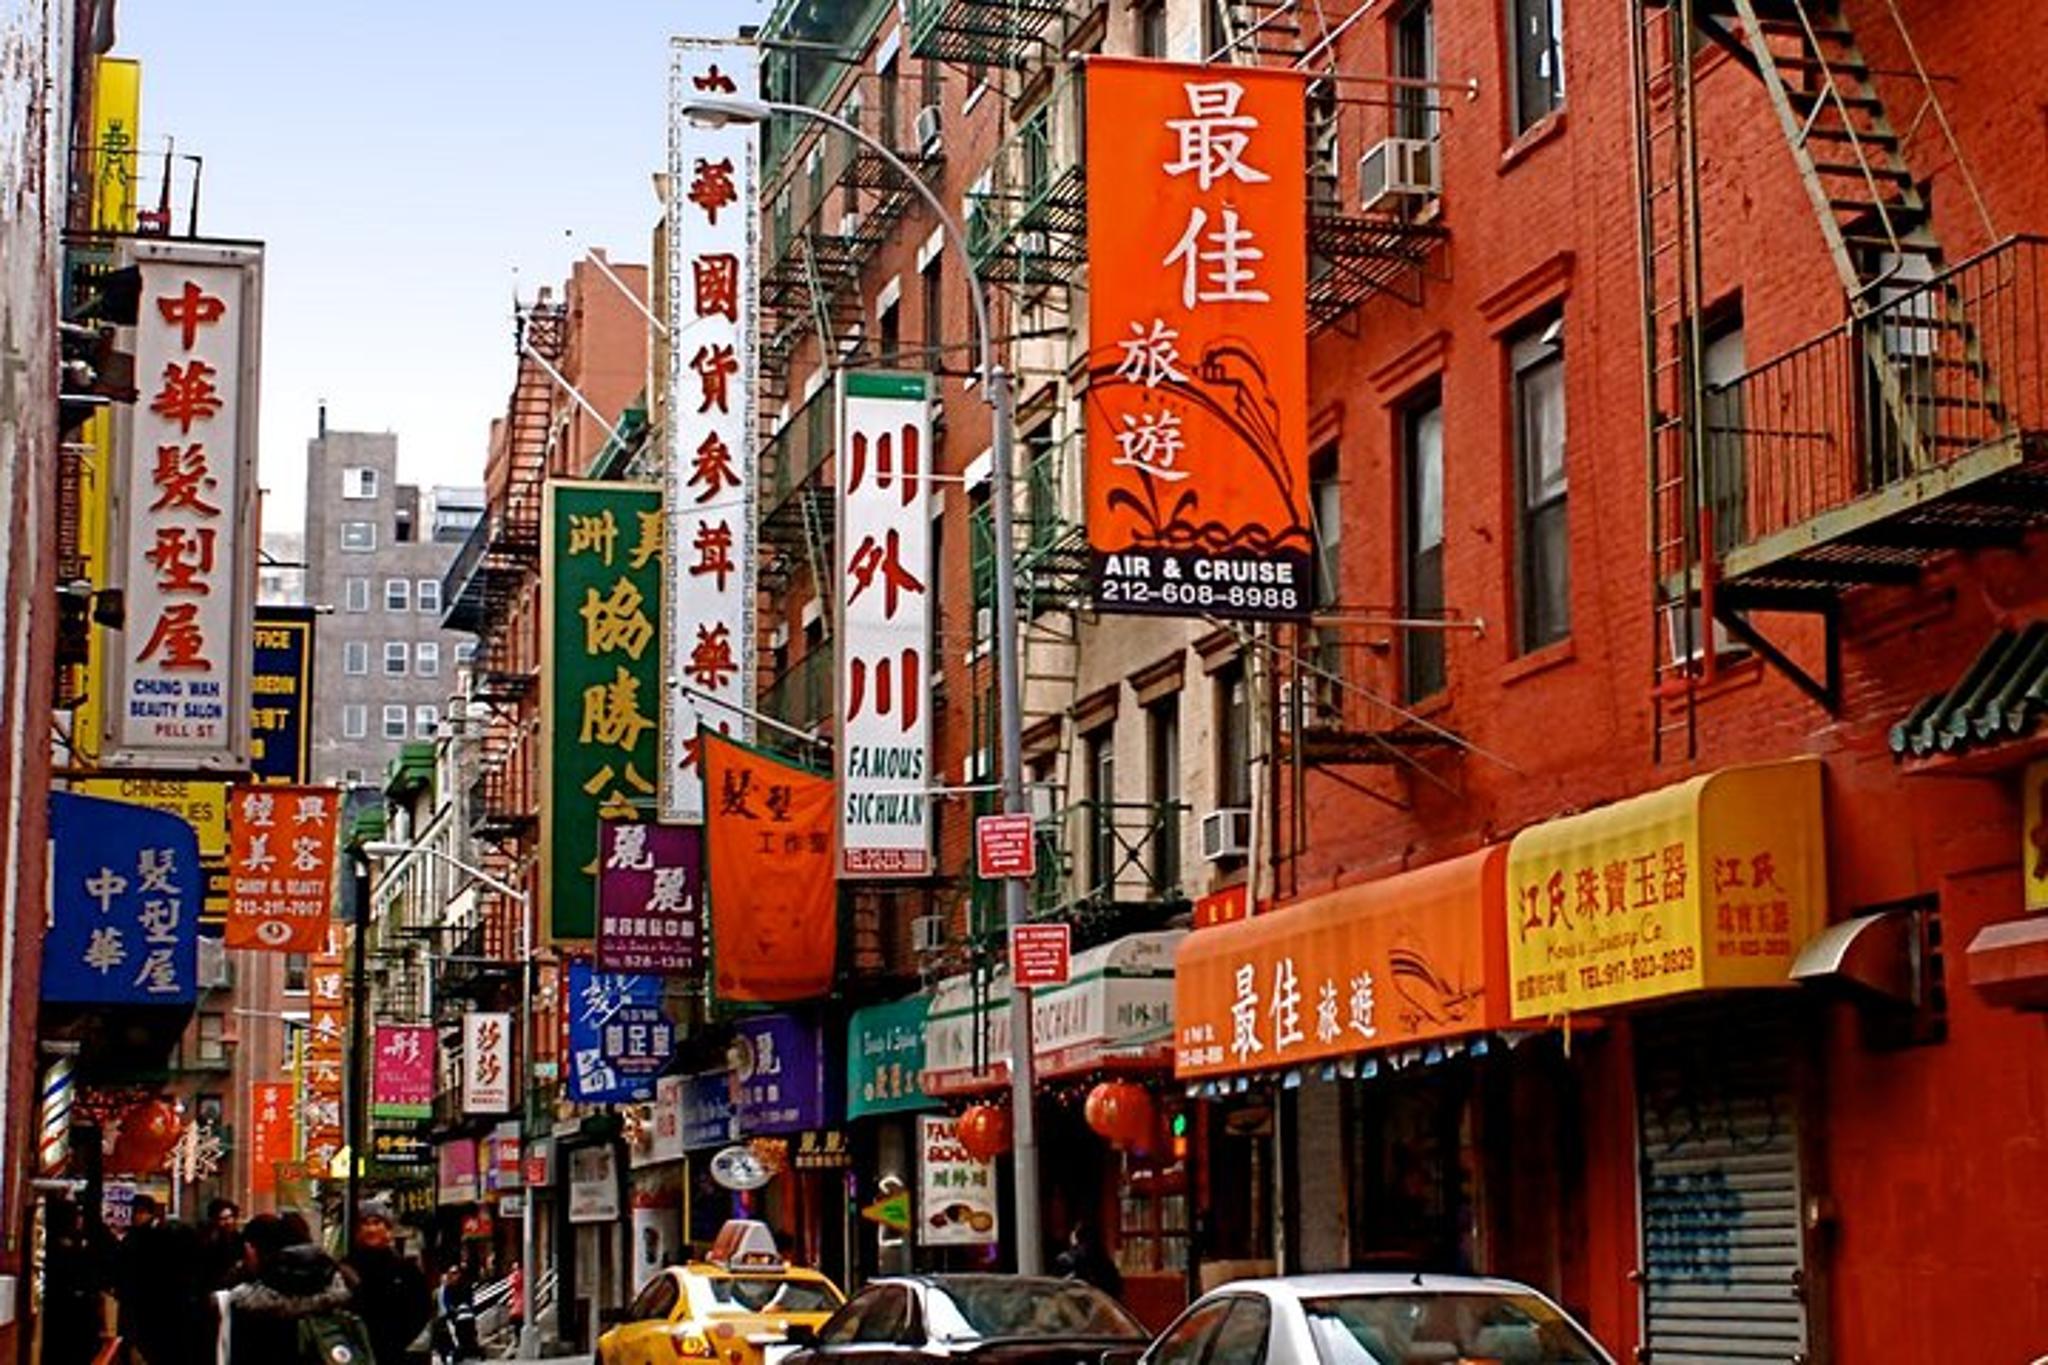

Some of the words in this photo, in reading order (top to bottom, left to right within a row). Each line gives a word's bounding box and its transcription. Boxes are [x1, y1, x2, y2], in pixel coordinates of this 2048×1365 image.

[1163, 81, 1271, 310] 最佳
[1111, 320, 1190, 481] 旅遊
[136, 281, 226, 671] 中華髮型屋
[847, 423, 924, 733] 川外川
[1103, 580, 1297, 609] 212-608-8988
[1105, 555, 1150, 577] AIR
[1163, 557, 1181, 579] &
[1194, 559, 1293, 584] CRUISE
[130, 701, 178, 717] BEAUTY
[185, 702, 222, 718] SALON
[134, 679, 182, 696] CHUNG
[156, 724, 188, 737] PELL
[197, 725, 214, 737] ST
[580, 577, 657, 875] 協勝公
[849, 746, 922, 779] FAMOUS
[120, 780, 189, 798] CHINESE
[847, 793, 922, 825] SICHUAN
[1519, 842, 1688, 944] 江氏珠寶玉器
[1715, 852, 1786, 897] 江氏
[83, 867, 129, 974] 中華
[133, 849, 182, 993] 髮型屋
[1231, 956, 1377, 1063] 最佳旅遊
